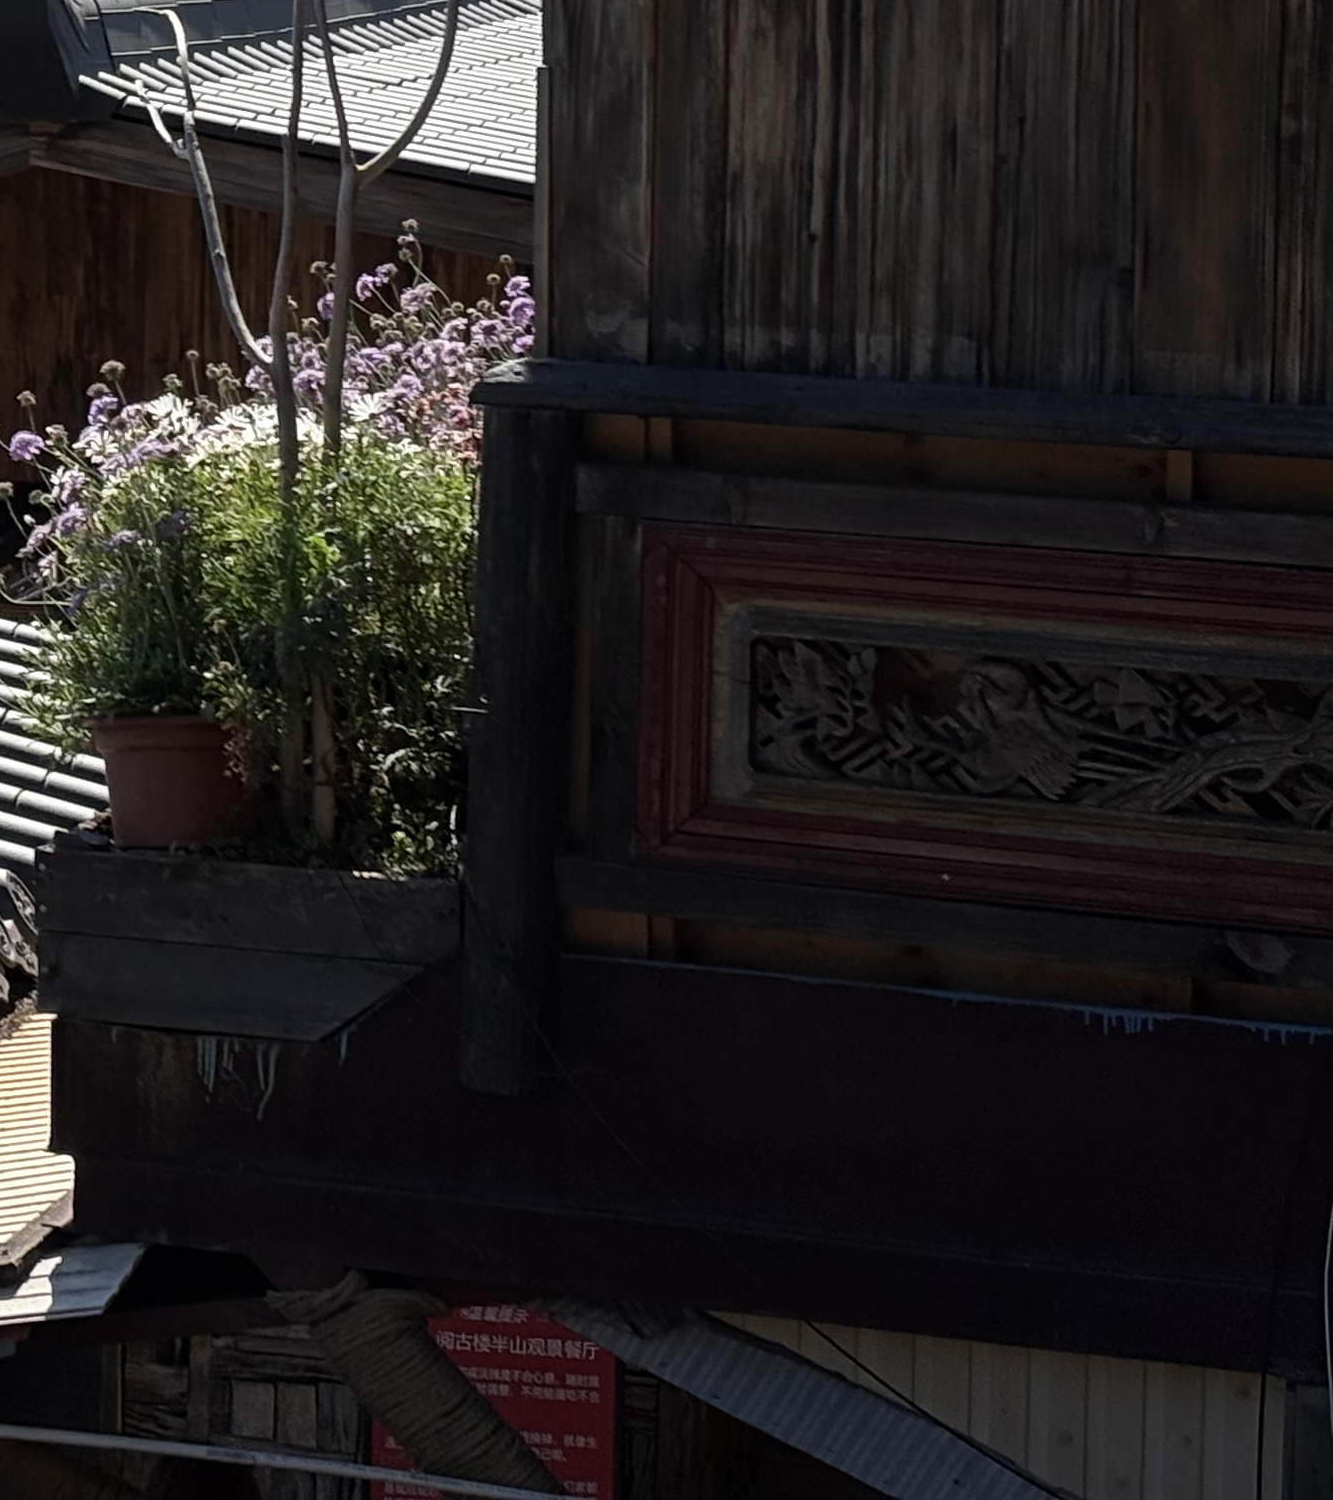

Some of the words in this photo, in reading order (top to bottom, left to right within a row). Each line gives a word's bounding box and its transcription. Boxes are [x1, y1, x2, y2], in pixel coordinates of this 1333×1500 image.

[436, 1330, 599, 1361] 阅古楼半山观景餐厅
